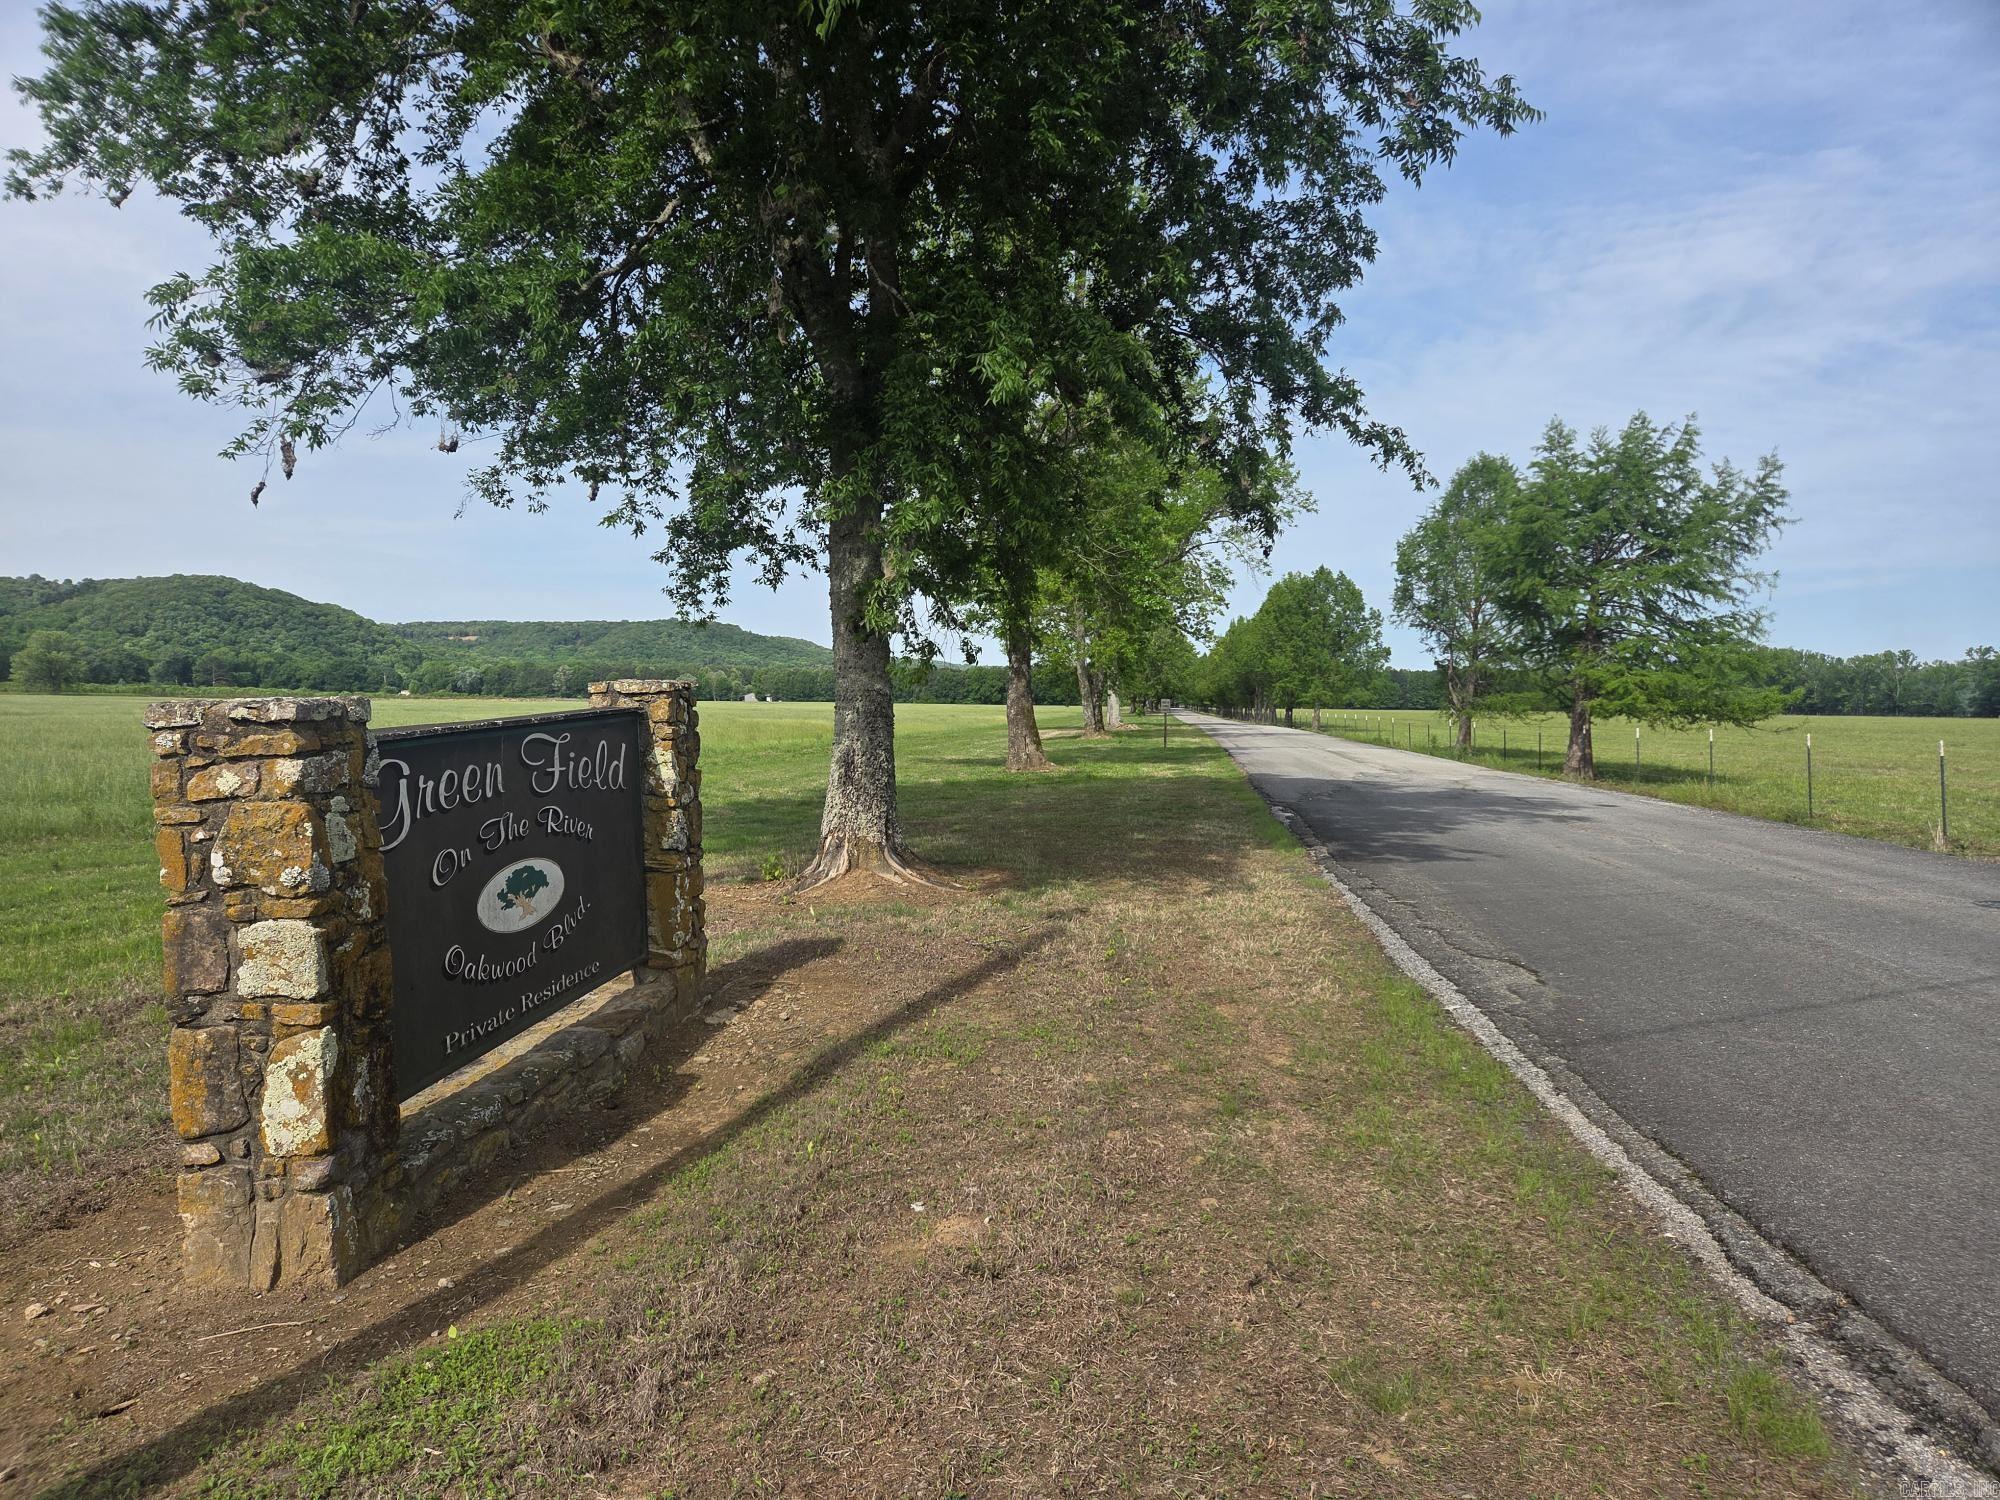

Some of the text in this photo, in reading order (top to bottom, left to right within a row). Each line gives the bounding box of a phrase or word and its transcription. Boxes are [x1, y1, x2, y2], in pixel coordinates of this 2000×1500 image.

[521, 732, 627, 794] Field
[432, 805, 594, 887] On The River
[444, 895, 592, 981] Oakwood Blvd.
[444, 959, 601, 1055] Private Residence
